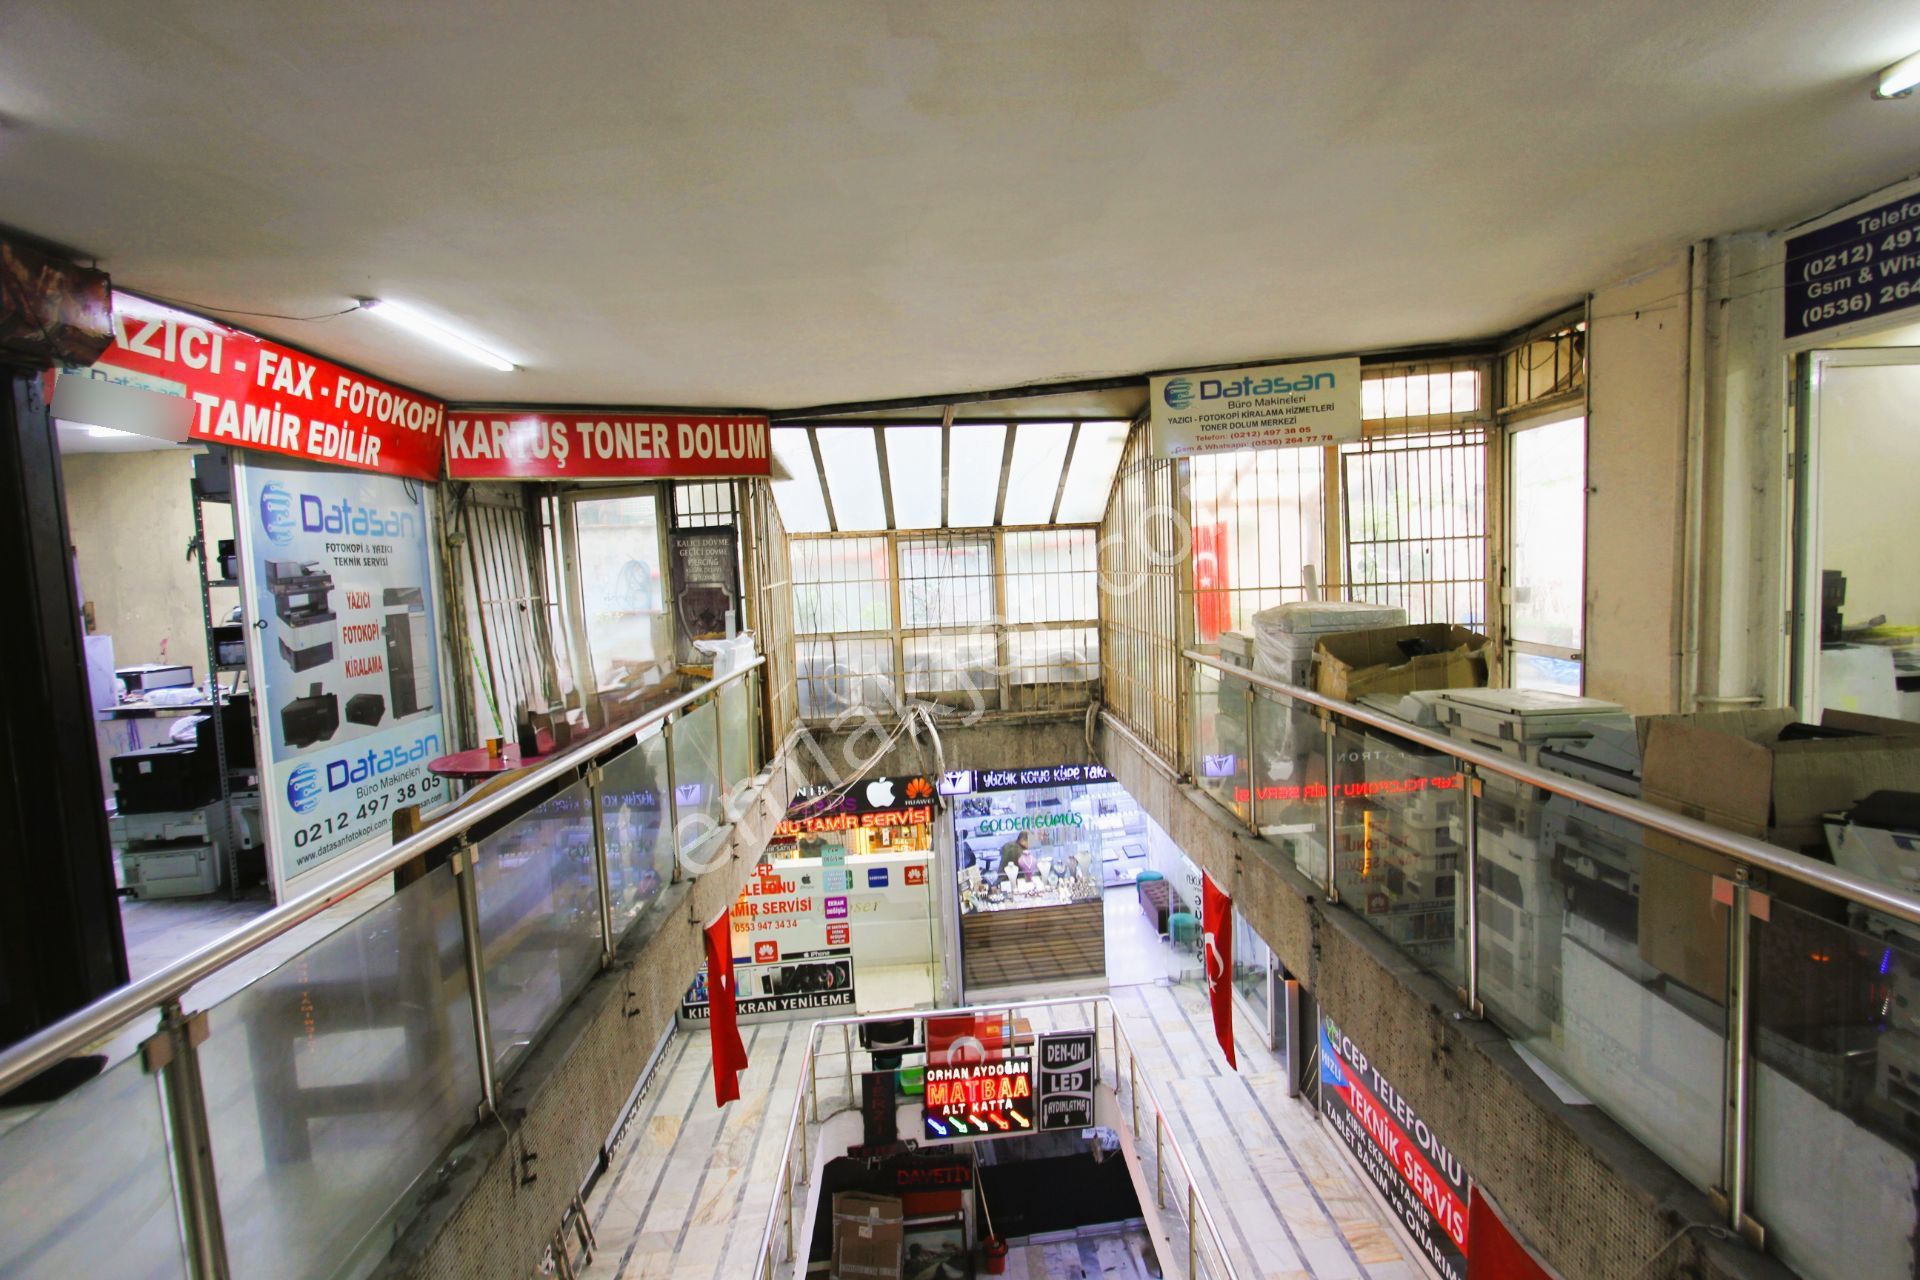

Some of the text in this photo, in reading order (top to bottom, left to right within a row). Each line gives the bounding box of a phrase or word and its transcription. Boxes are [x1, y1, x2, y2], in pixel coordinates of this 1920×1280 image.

[1803, 243, 1873, 282] (0212)
[1807, 275, 1851, 298] Gsm
[1858, 267, 1873, 283] &
[1802, 292, 1871, 327] (0536)
[257, 350, 316, 400] FAX
[336, 376, 444, 437] FOTOKOPİ
[1200, 372, 1335, 400] Datasan
[1168, 416, 1193, 424] YAZICI
[1199, 411, 1240, 422] FOTOKOPİ
[1241, 408, 1284, 419] KİRALAMA
[1285, 403, 1335, 415] HİZMETLERİ
[1228, 395, 1306, 410] Büro Makineleri
[194, 394, 381, 467] TAMİR EDİLİR
[1200, 417, 1297, 432] TONER DOLUM MERKEZİ
[1231, 431, 1260, 440] (0212)
[1263, 428, 1280, 436] 497
[1299, 426, 1311, 434] 05
[448, 419, 767, 468] KARTUŞ TONER DOLUM
[1252, 438, 1282, 447] (0536)
[1285, 436, 1303, 444] 264
[1306, 435, 1320, 443] 77
[300, 493, 415, 538] Datasan
[325, 541, 364, 553] FOTOKOPİ
[372, 543, 393, 554] YAZICI
[333, 554, 361, 566] TEKNİK
[346, 592, 371, 610] YAZICI
[343, 619, 380, 645] FOTOKOPİ
[345, 655, 383, 679] KİRALAMA
[326, 734, 439, 793] Datasan
[356, 766, 421, 800] Büro Makineleri
[294, 811, 349, 848] 0212
[356, 793, 390, 820] 497
[397, 782, 416, 804] 38
[421, 774, 441, 793] 05
[861, 805, 930, 828] SERVİSİ
[762, 896, 812, 915] SERVİSİ
[735, 921, 755, 932] 0553
[757, 920, 772, 931] 947
[736, 1002, 777, 1015] KRAN
[781, 993, 850, 1010] YENİLEME
[1047, 1042, 1086, 1062] DEN-UM
[927, 1068, 969, 1082] ORHAN
[1321, 1048, 1342, 1083] HIZLI
[927, 1076, 1030, 1105] MATBAA
[1051, 1074, 1083, 1092] LED
[943, 1098, 1014, 1116] ALT KATTA
[1343, 1035, 1463, 1188] CEP TELEFONU
[1326, 1099, 1356, 1148] TABLET
[1357, 1143, 1389, 1196] BAKIM
[1390, 1190, 1404, 1215] ve
[1346, 1108, 1430, 1230] KIRIK EKRAN TAMİR
[1348, 1081, 1464, 1244] TEKNİK SERVİS
